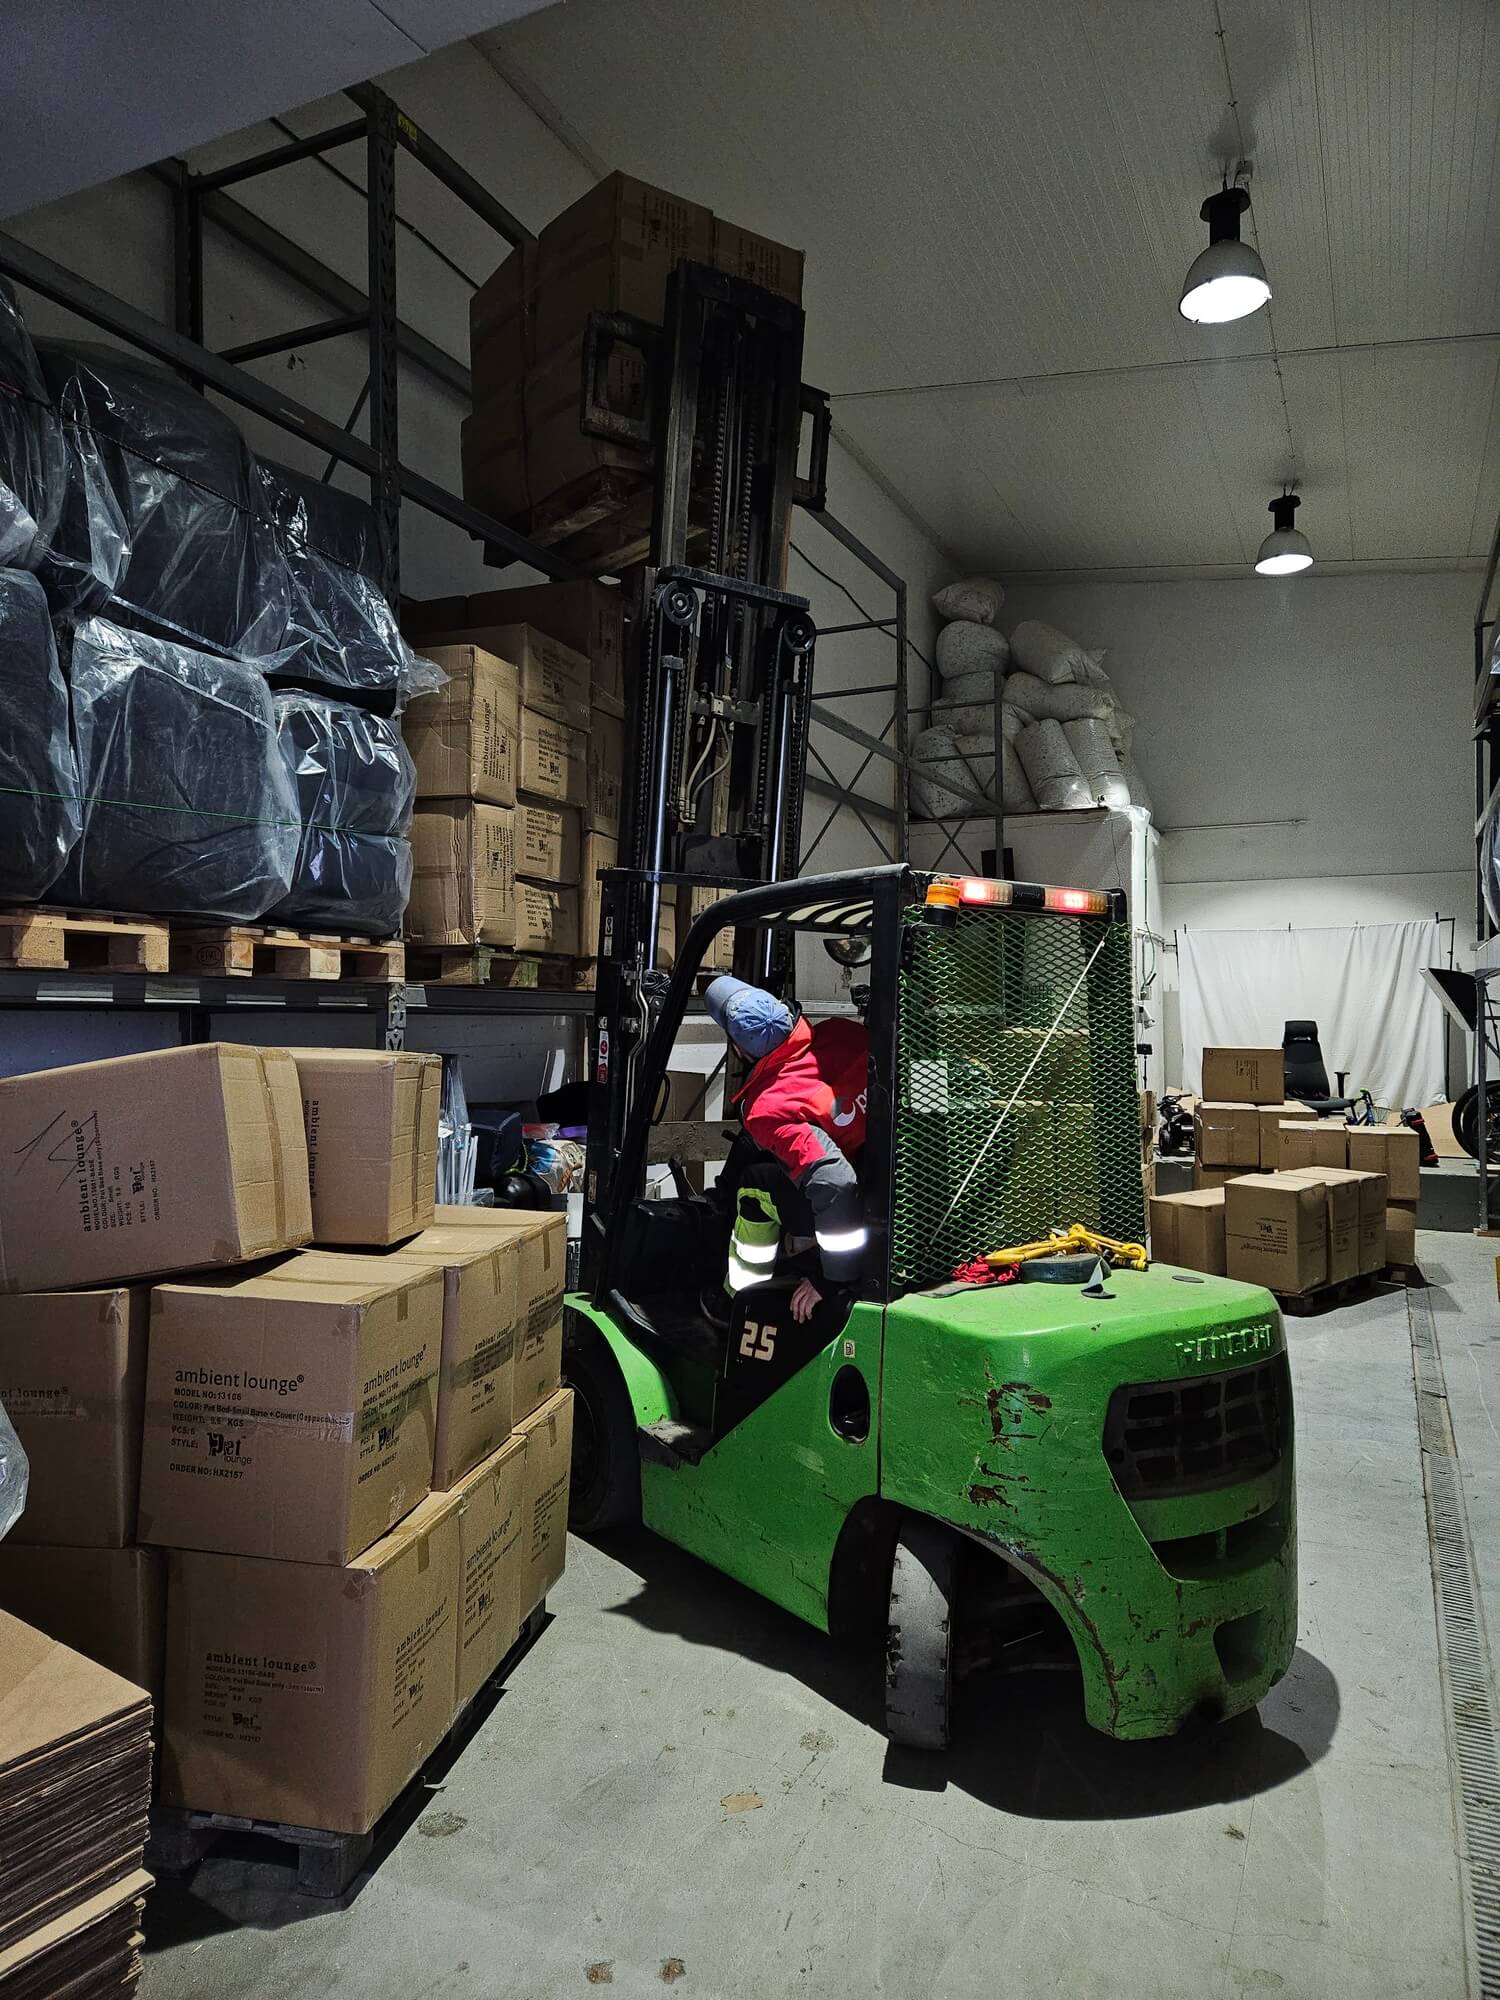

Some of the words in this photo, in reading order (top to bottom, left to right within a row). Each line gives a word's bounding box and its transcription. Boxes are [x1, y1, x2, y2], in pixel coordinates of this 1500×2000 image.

[78, 1178, 91, 1232] ambient
[740, 1320, 777, 1361] 25
[176, 1368, 239, 1387] ambient
[364, 1364, 398, 1394] ambient
[174, 1388, 200, 1398] MODEL
[173, 1401, 202, 1411] COLOR:
[173, 1414, 205, 1424] WEIGHT:
[228, 1419, 244, 1428] KGS
[171, 1438, 198, 1449] STYLE:
[224, 1455, 252, 1466] lounge
[170, 1463, 196, 1474] ORDER
[206, 1653, 258, 1666] ambient
